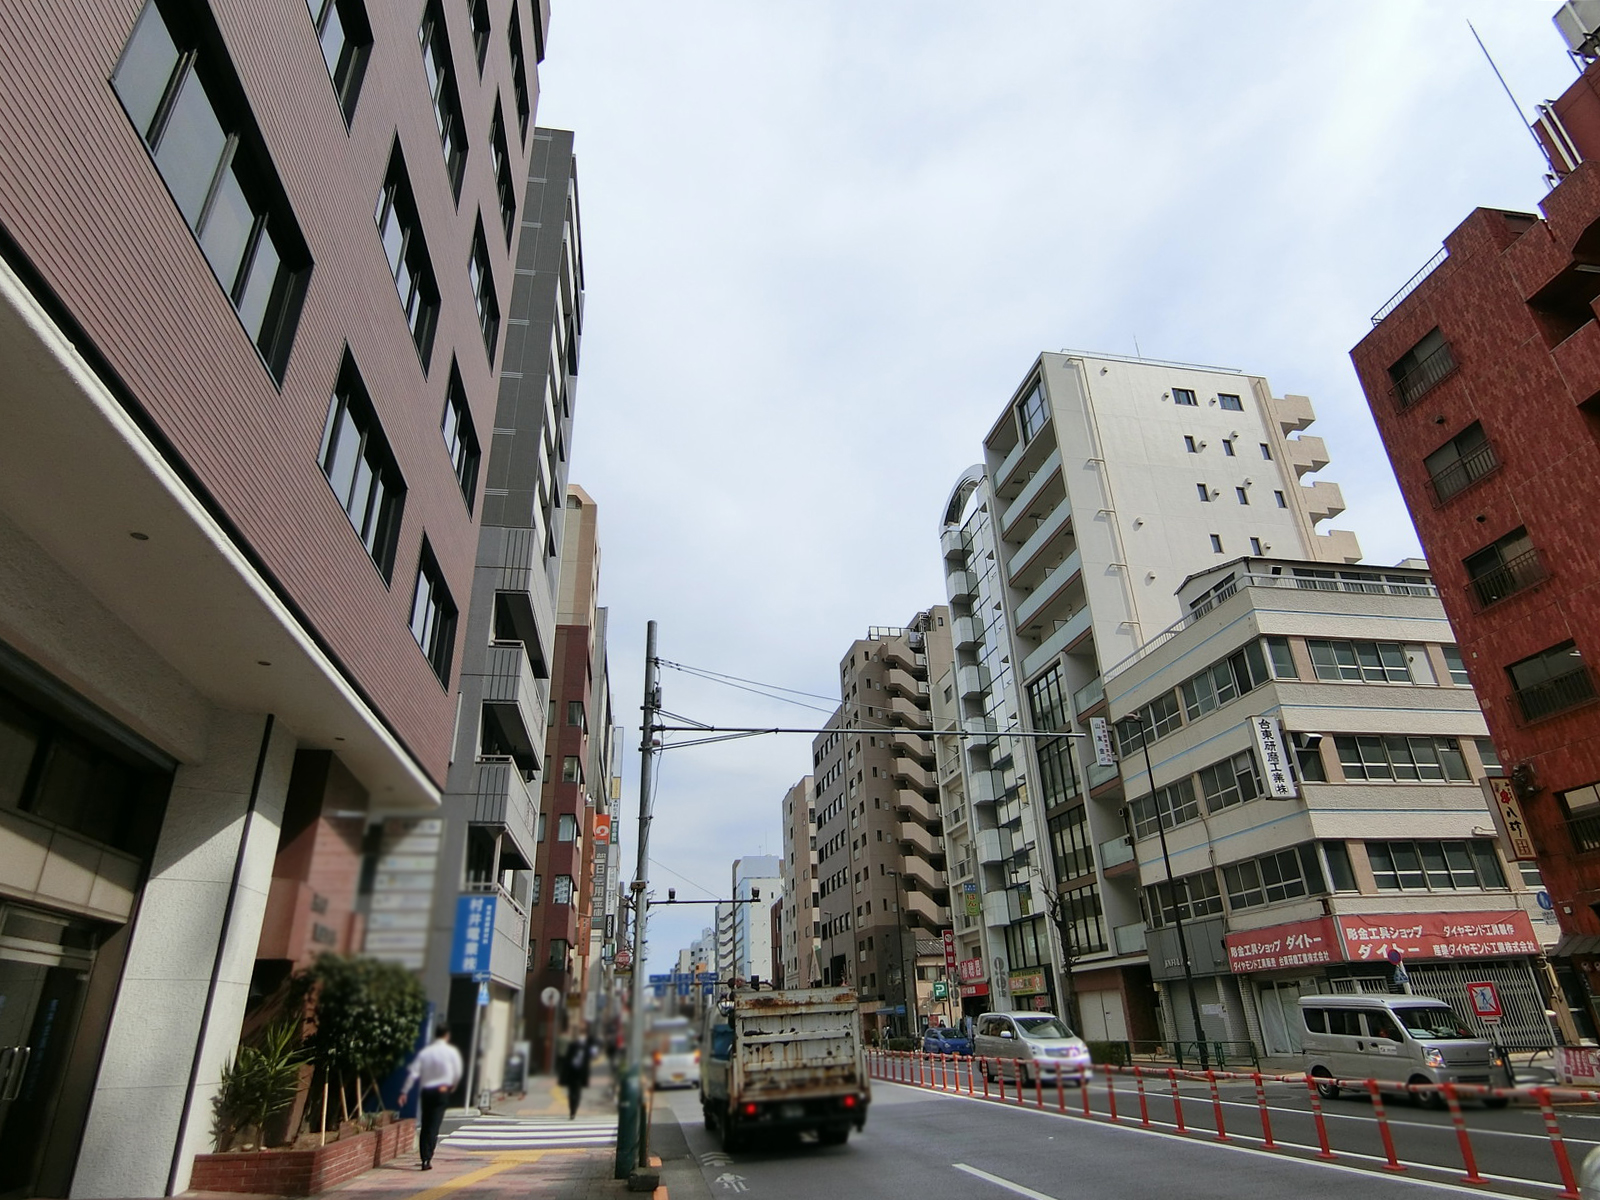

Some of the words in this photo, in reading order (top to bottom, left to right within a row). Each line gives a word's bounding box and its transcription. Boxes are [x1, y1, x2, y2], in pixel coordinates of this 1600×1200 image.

[1285, 933, 1322, 950] ダイトー
[935, 984, 945, 996] P
